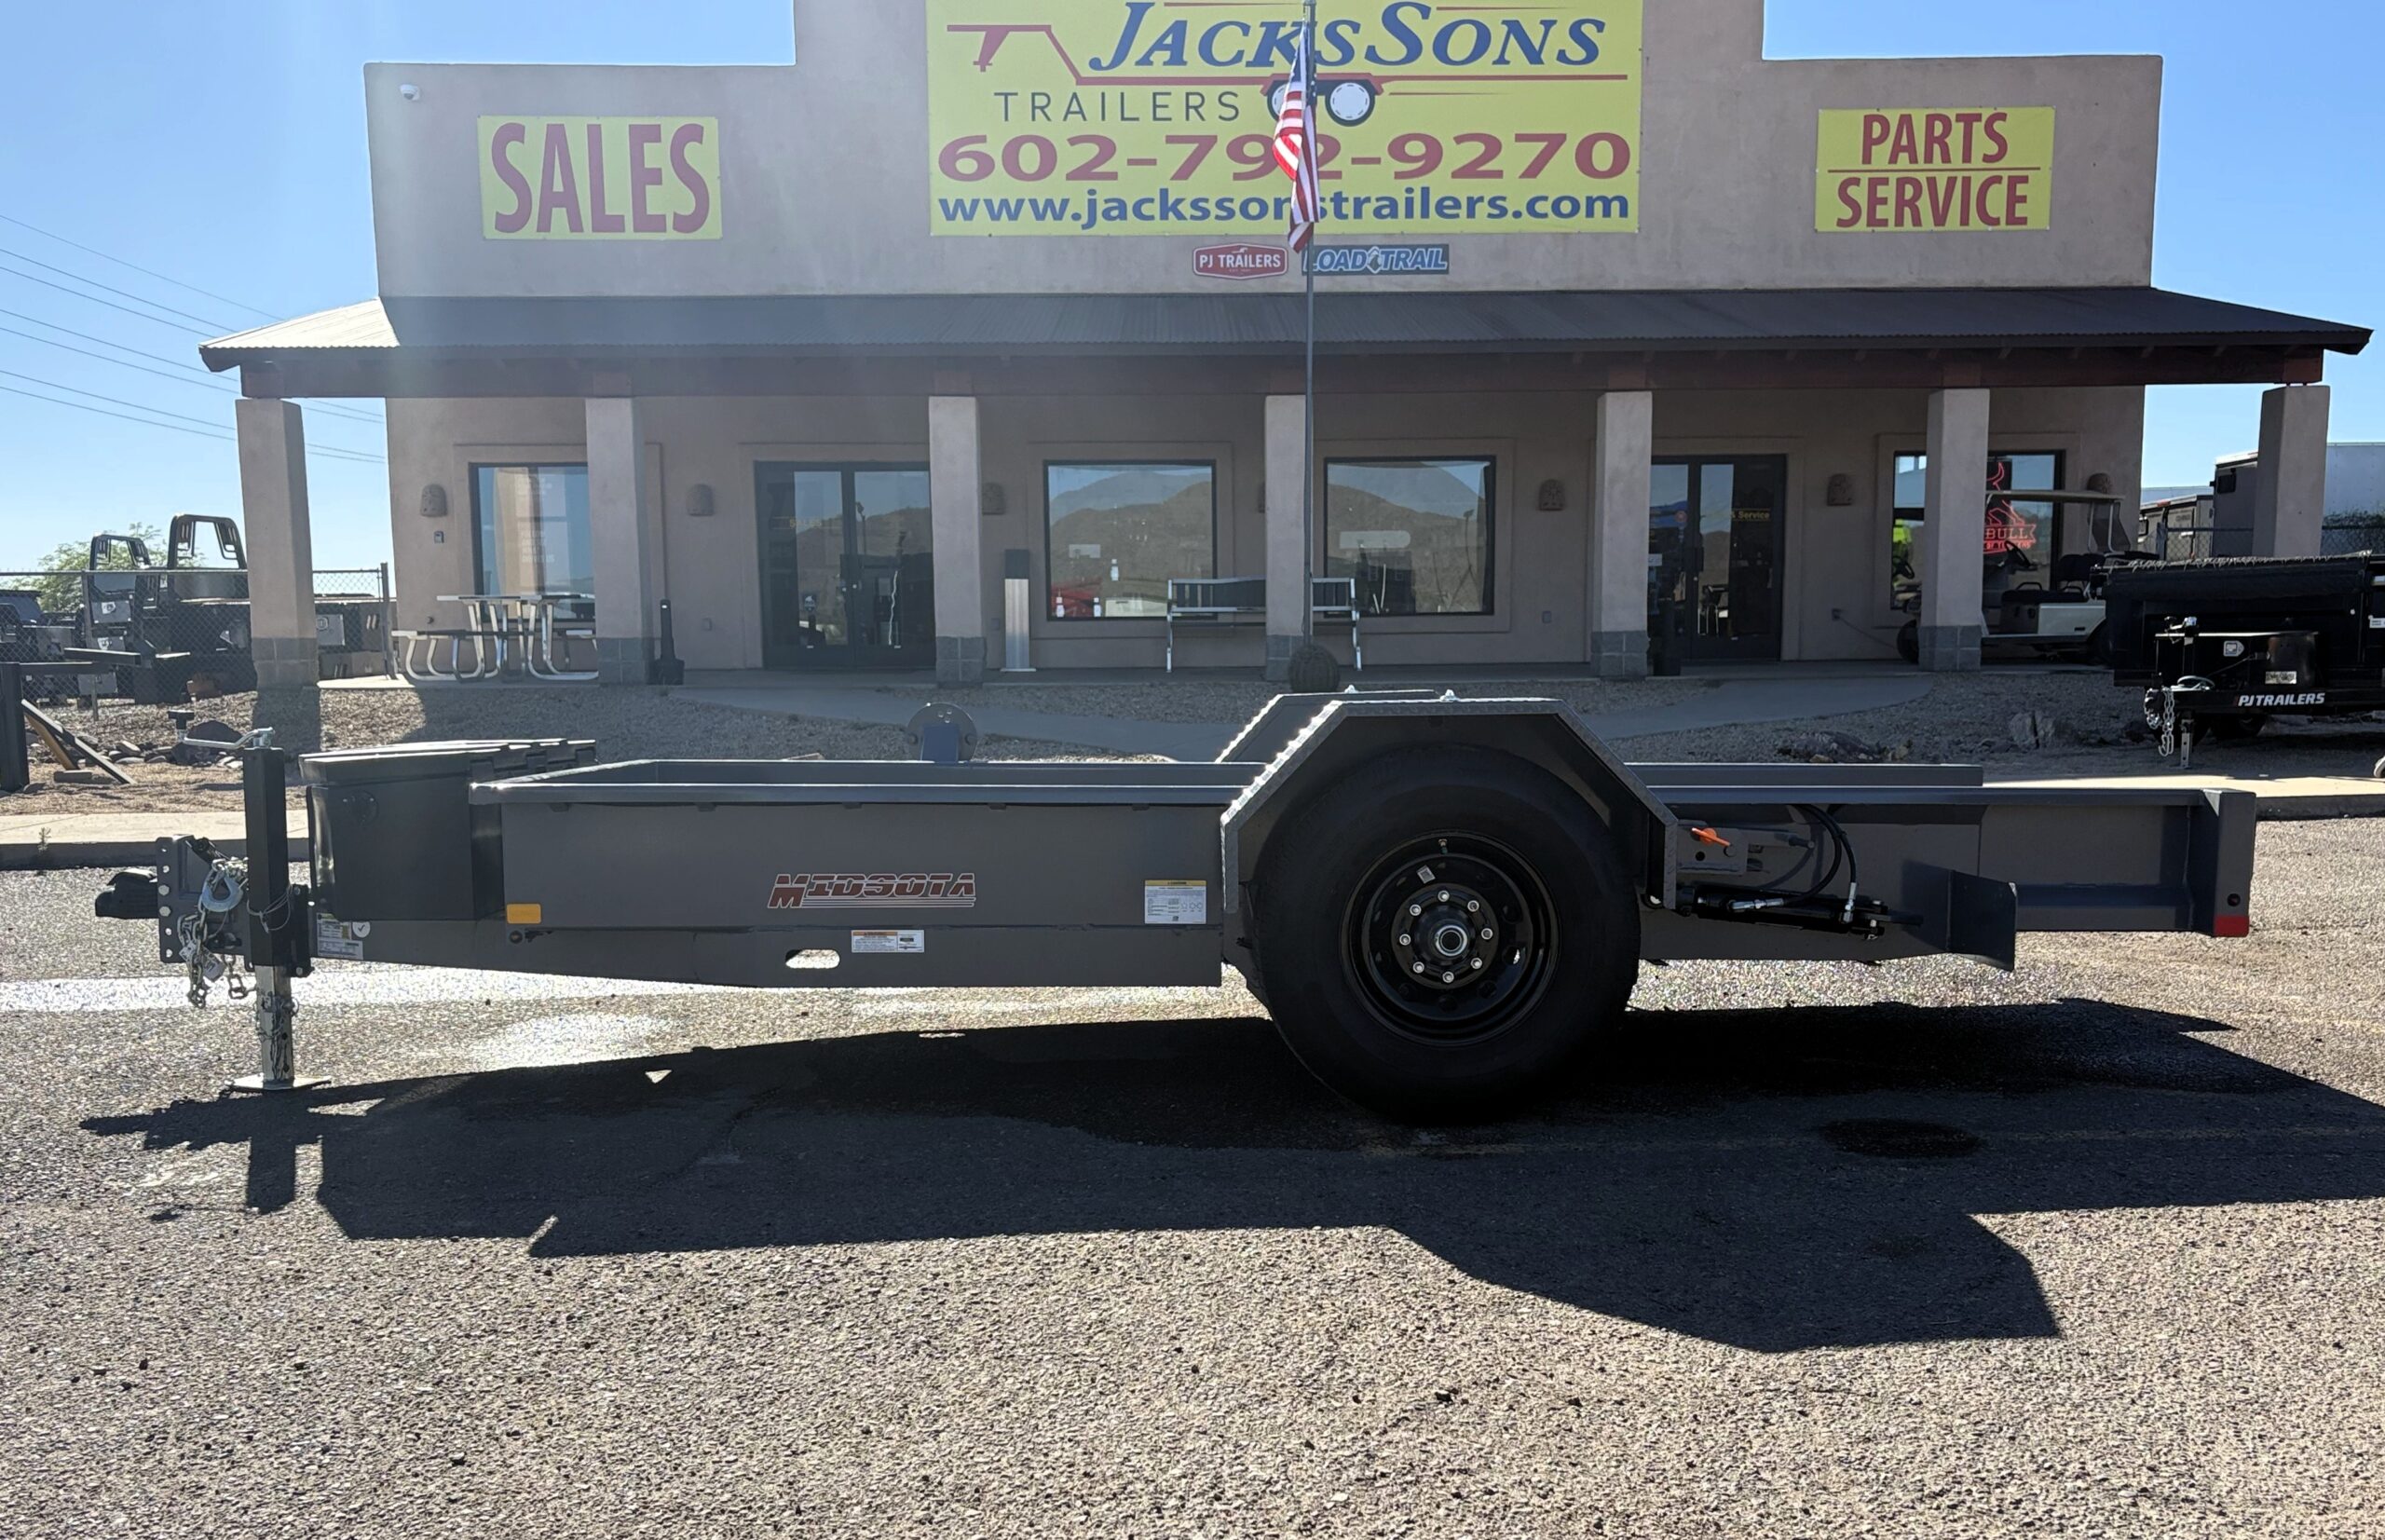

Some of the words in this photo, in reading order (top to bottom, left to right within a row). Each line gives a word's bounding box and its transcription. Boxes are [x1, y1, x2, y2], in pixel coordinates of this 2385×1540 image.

[993, 91, 1241, 123] TRAILERS
[1861, 112, 2009, 165] PARTS
[937, 132, 1631, 182] 602-792-9270
[491, 122, 710, 234] SALES
[1835, 174, 2029, 228] SERVICE
[1199, 253, 1213, 268] PJ
[1218, 253, 1281, 268] TRAILERS
[1381, 248, 1448, 270] TRAIL
[1986, 527, 2028, 539] BULL
[2256, 692, 2325, 706] TRAILERS
[768, 873, 975, 909] MIDSOTA
